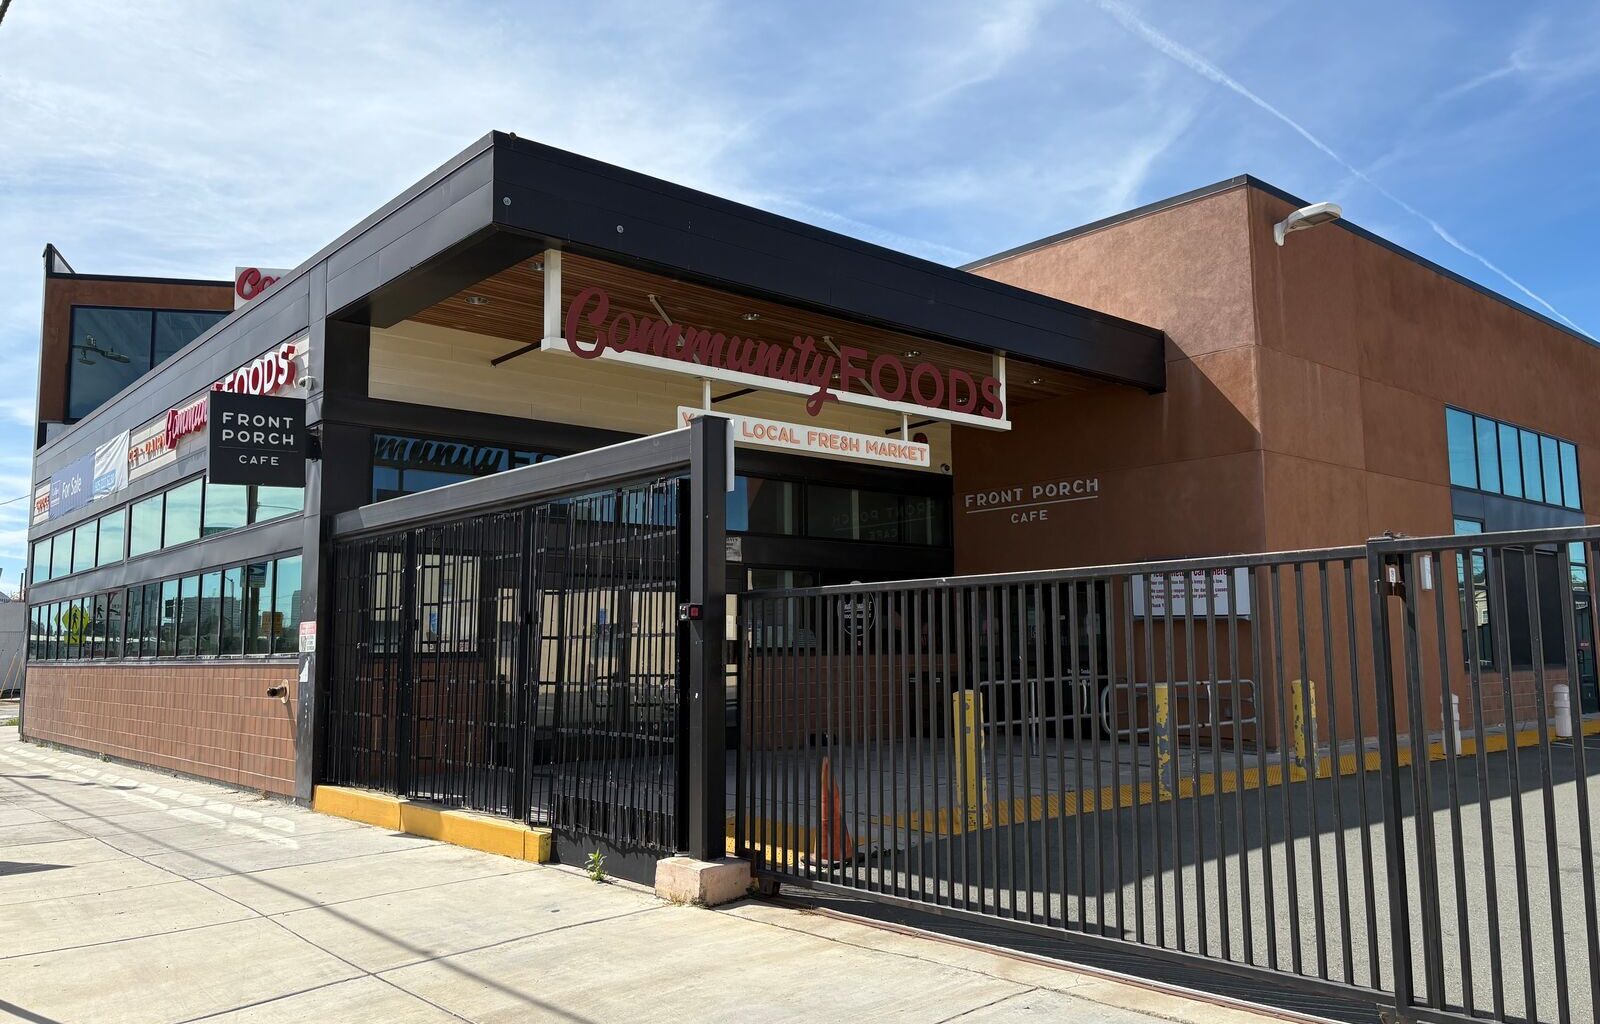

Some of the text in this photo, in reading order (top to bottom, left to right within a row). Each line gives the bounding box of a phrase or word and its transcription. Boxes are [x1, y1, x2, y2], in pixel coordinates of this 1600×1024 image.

[564, 286, 1004, 420] Community FOODS
[222, 411, 294, 429] FRONT
[222, 429, 294, 446] PORCH
[742, 420, 927, 462] LOCAL FRESH MARKET
[238, 454, 280, 466] CAFE
[62, 481, 71, 500] For
[71, 473, 82, 496] Sale
[965, 477, 1099, 508] FRONT PORCH
[1010, 509, 1049, 524] CAFE
